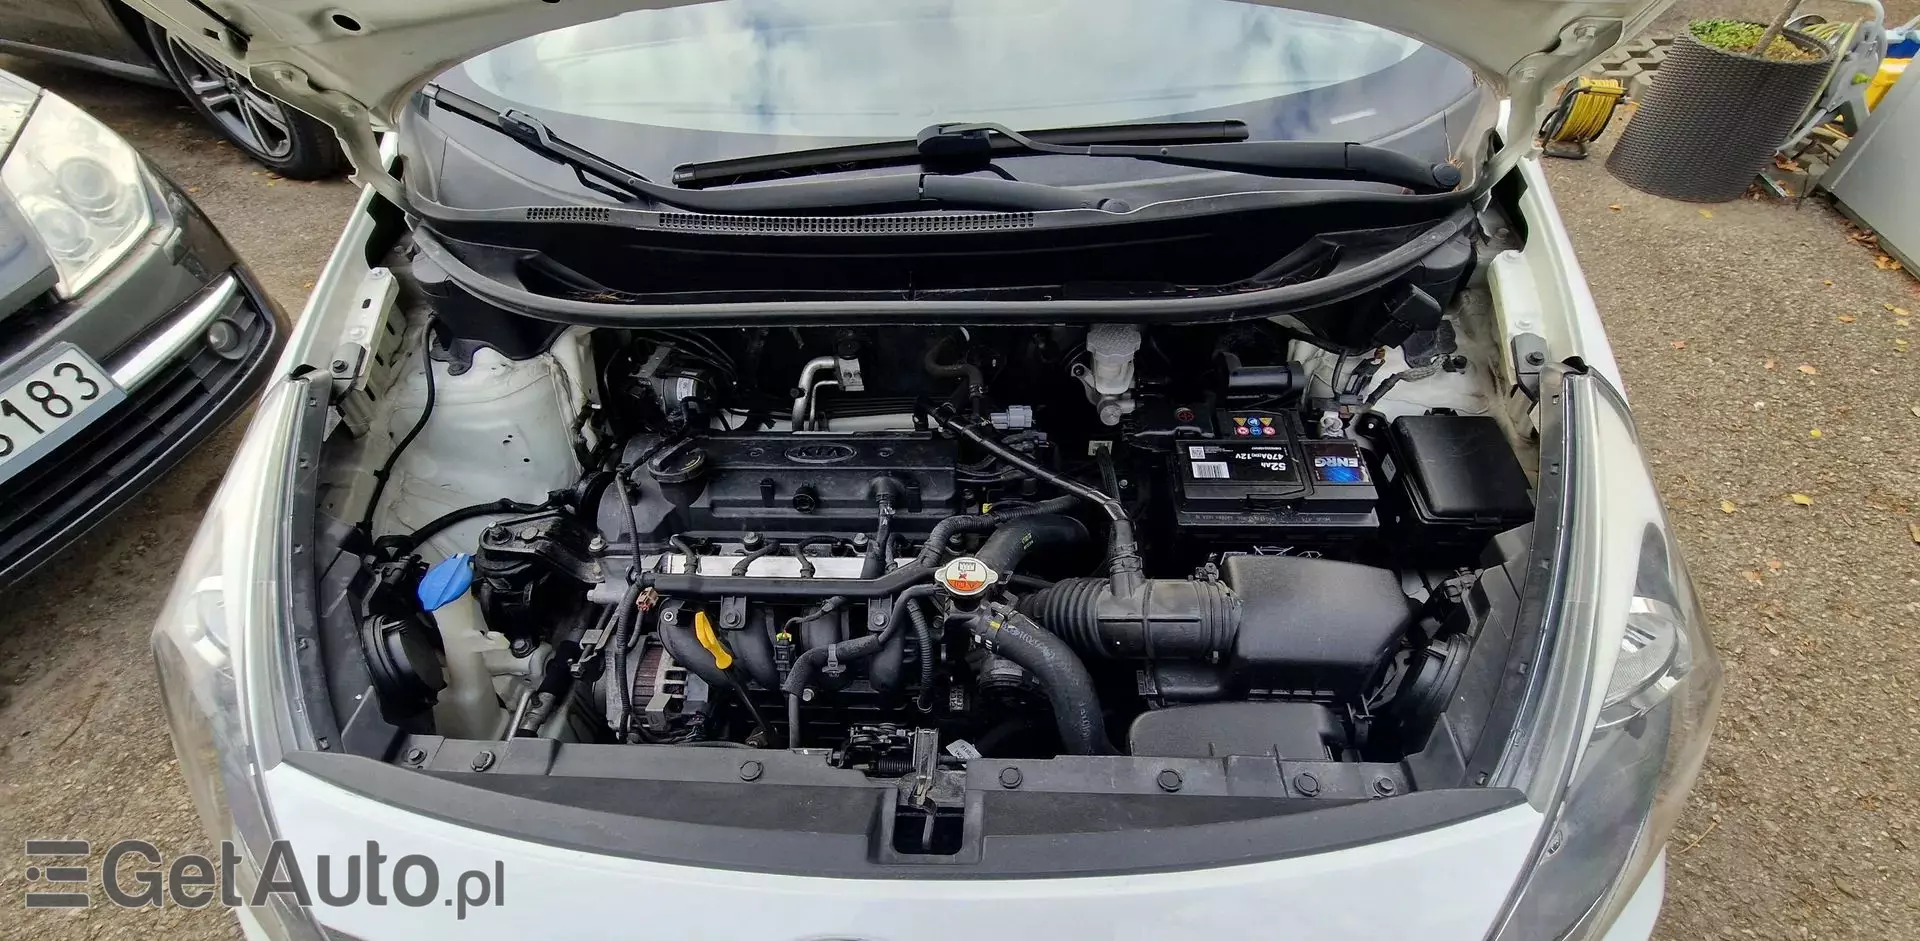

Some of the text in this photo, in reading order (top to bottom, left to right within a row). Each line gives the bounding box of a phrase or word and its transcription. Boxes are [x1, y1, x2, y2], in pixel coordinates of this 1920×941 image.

[797, 446, 843, 458] KIA
[1260, 461, 1287, 471] 52Ah
[1314, 456, 1359, 468] ENRG
